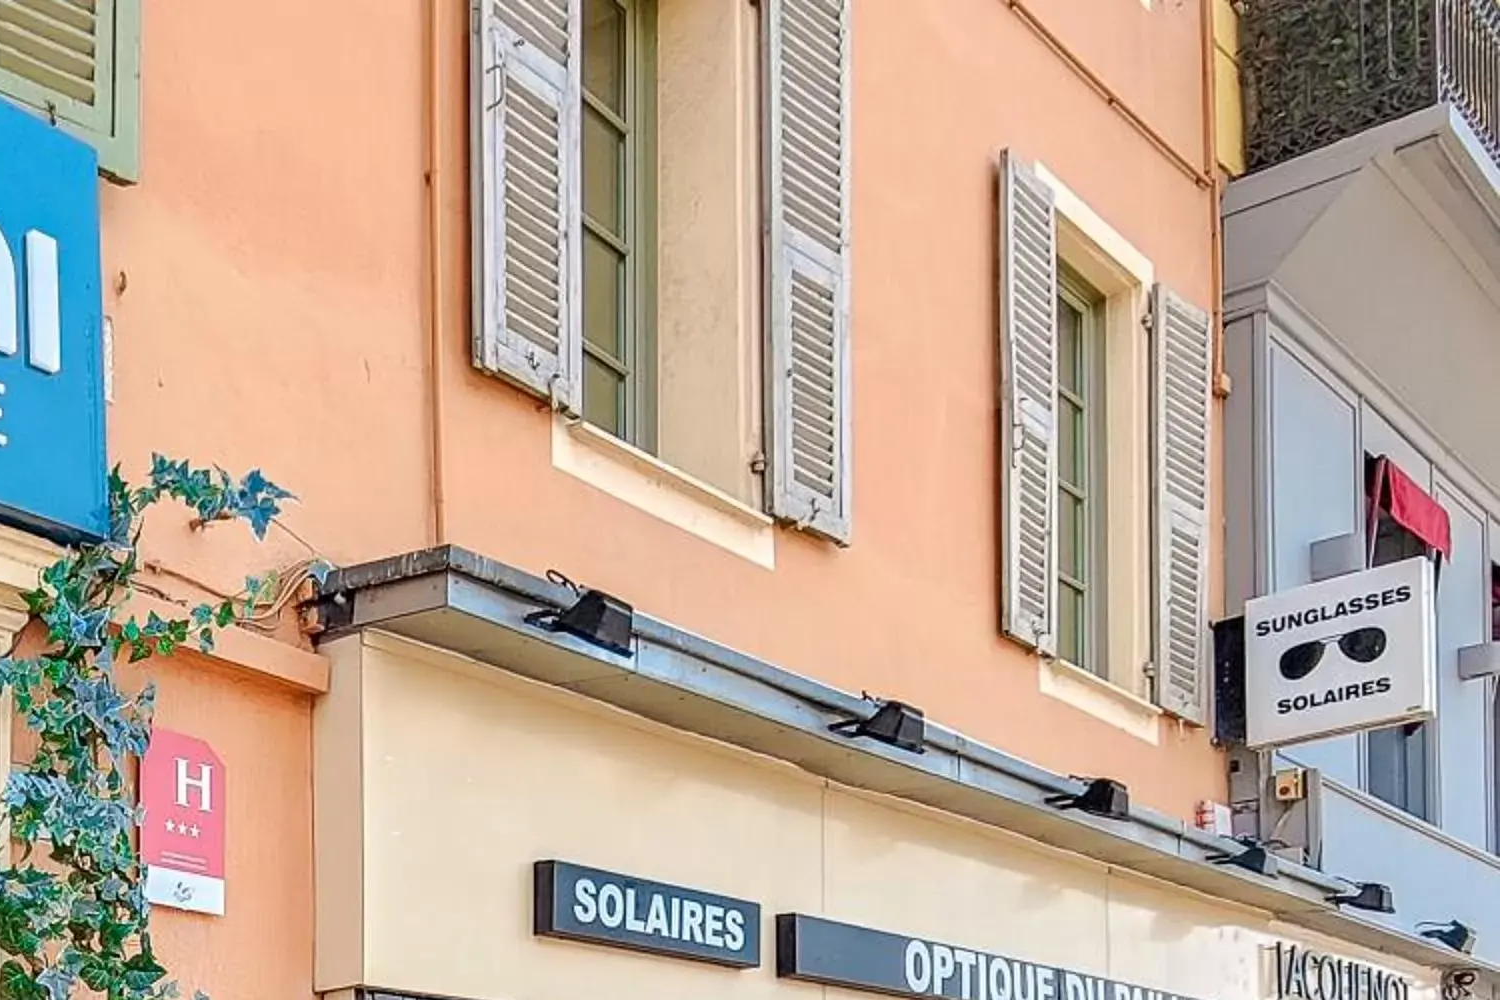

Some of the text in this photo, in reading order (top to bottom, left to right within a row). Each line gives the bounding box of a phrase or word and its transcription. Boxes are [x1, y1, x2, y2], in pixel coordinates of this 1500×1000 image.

[1255, 585, 1412, 637] SUNGLASSES
[1276, 677, 1392, 714] SOLAIRES
[173, 756, 213, 813] H
[573, 877, 746, 951] SOLAIRES
